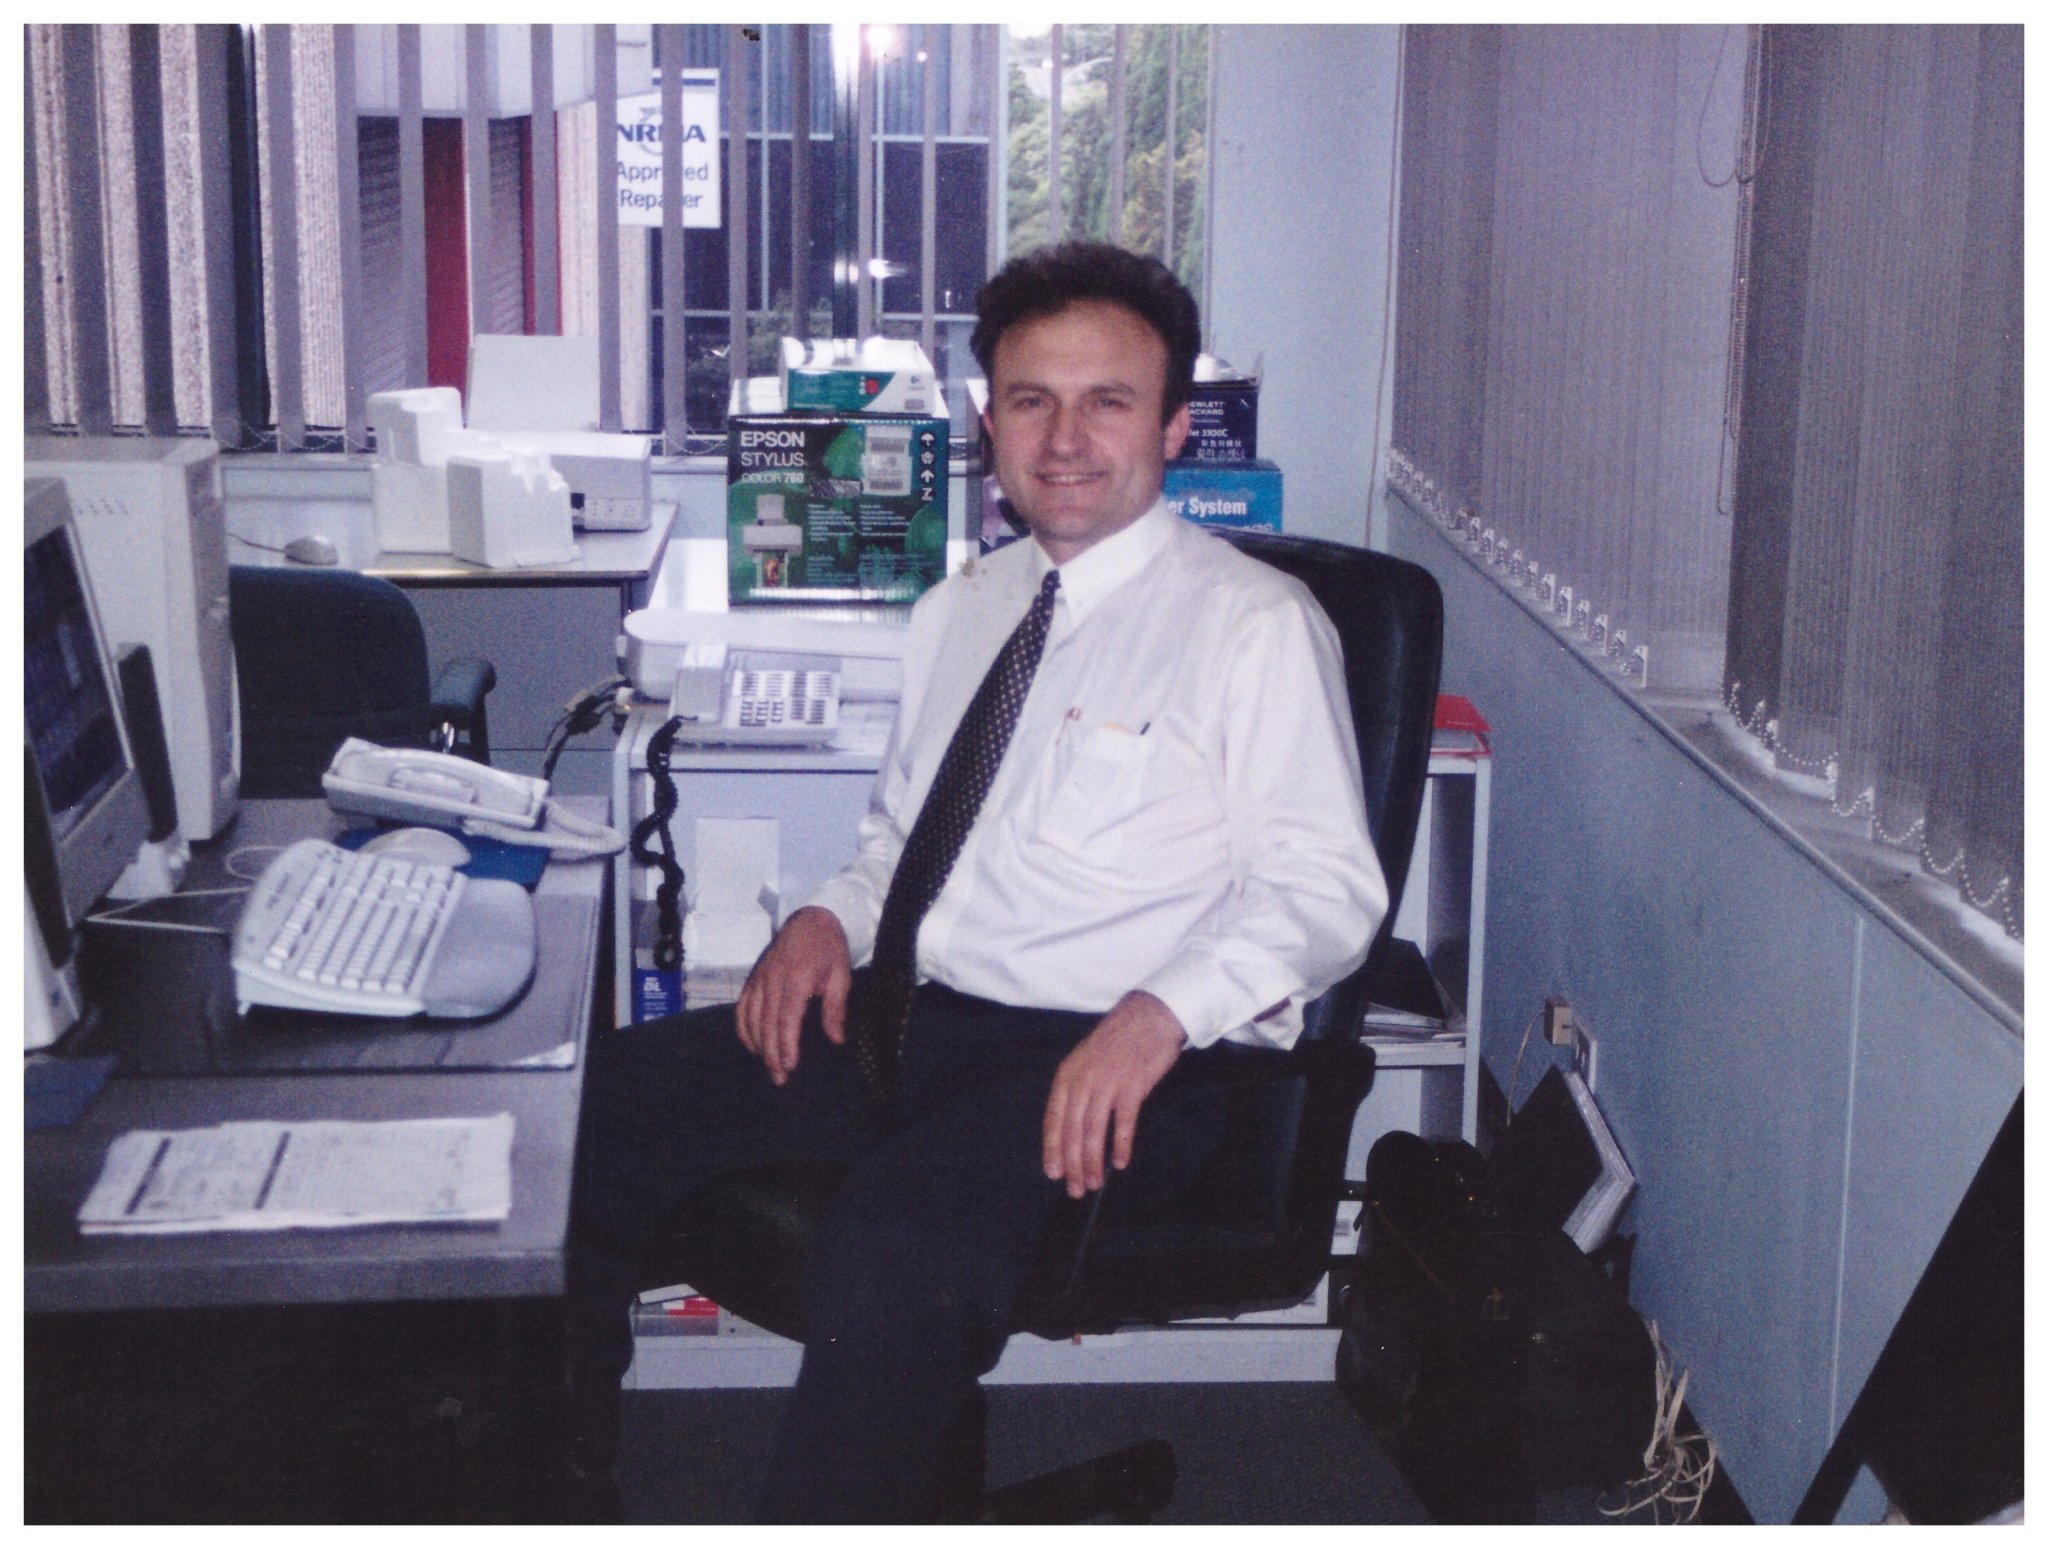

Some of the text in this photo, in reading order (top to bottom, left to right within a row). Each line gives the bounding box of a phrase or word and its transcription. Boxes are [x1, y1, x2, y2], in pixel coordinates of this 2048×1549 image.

[617, 161, 708, 183] Appred
[620, 189, 703, 211] Repaer
[1189, 408, 1224, 416] ACKARD
[740, 430, 805, 448] EPSON
[740, 451, 805, 467] STYLUS
[741, 472, 804, 483] COLOR 760
[1168, 496, 1247, 518] er System
